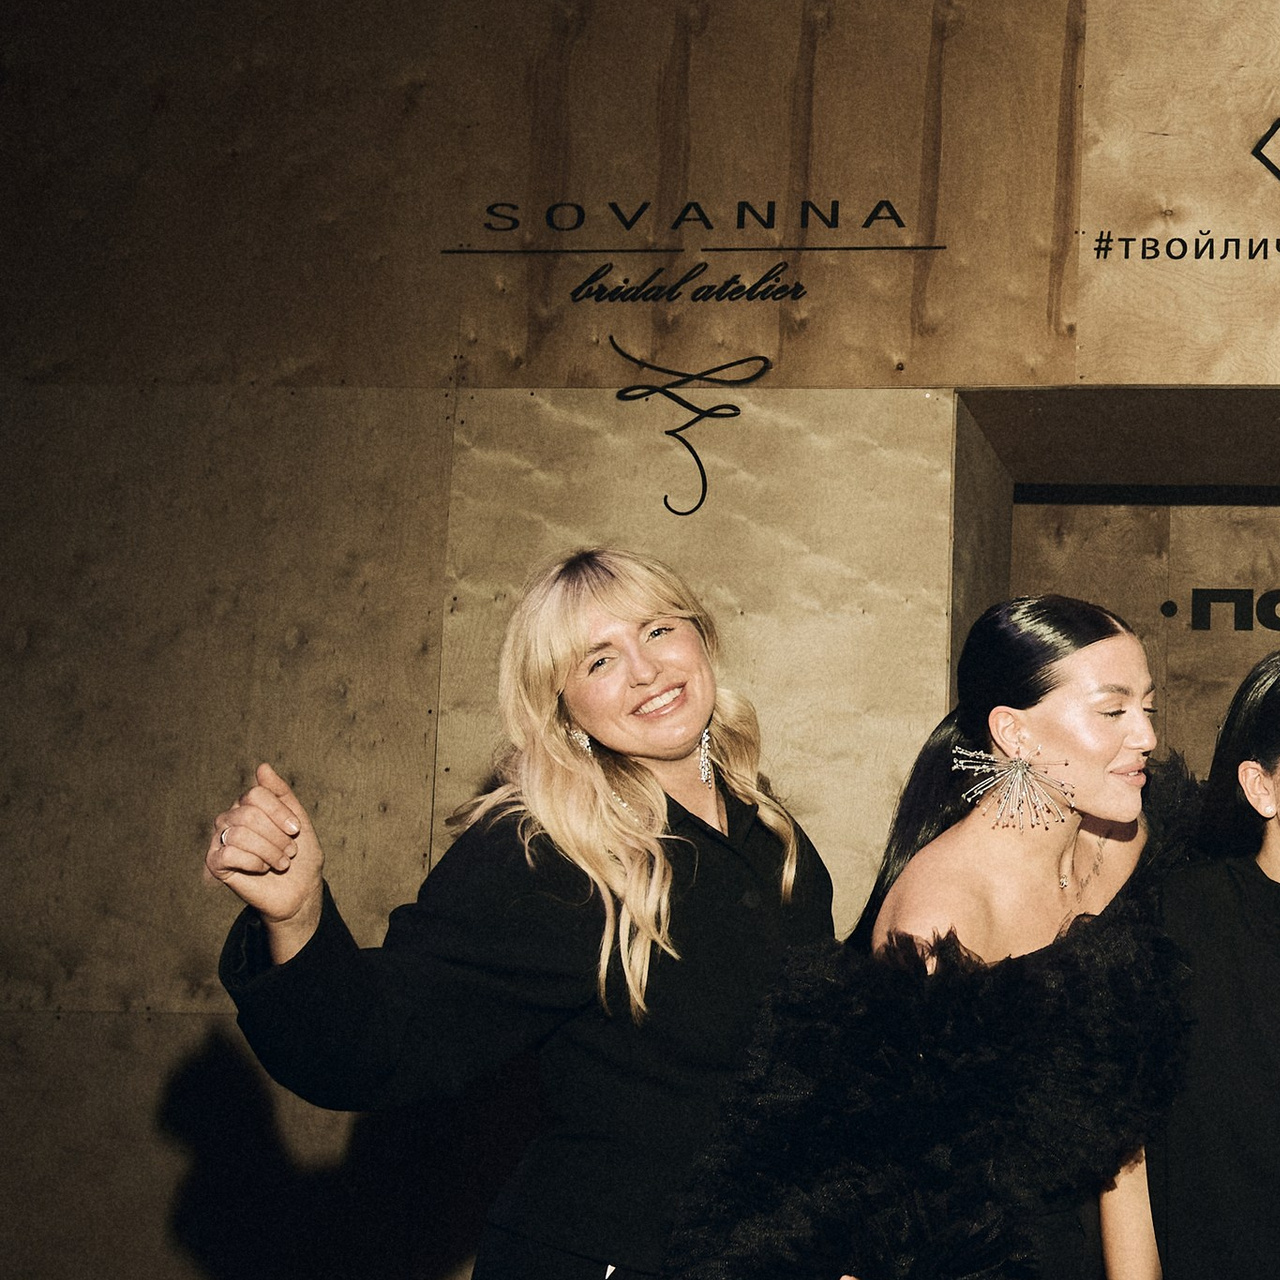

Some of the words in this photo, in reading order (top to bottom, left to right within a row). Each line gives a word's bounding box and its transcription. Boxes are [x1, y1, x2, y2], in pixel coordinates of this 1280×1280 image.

[484, 200, 905, 231] SOVANNA
[570, 262, 684, 303] bridal
[690, 261, 807, 302] atelier
